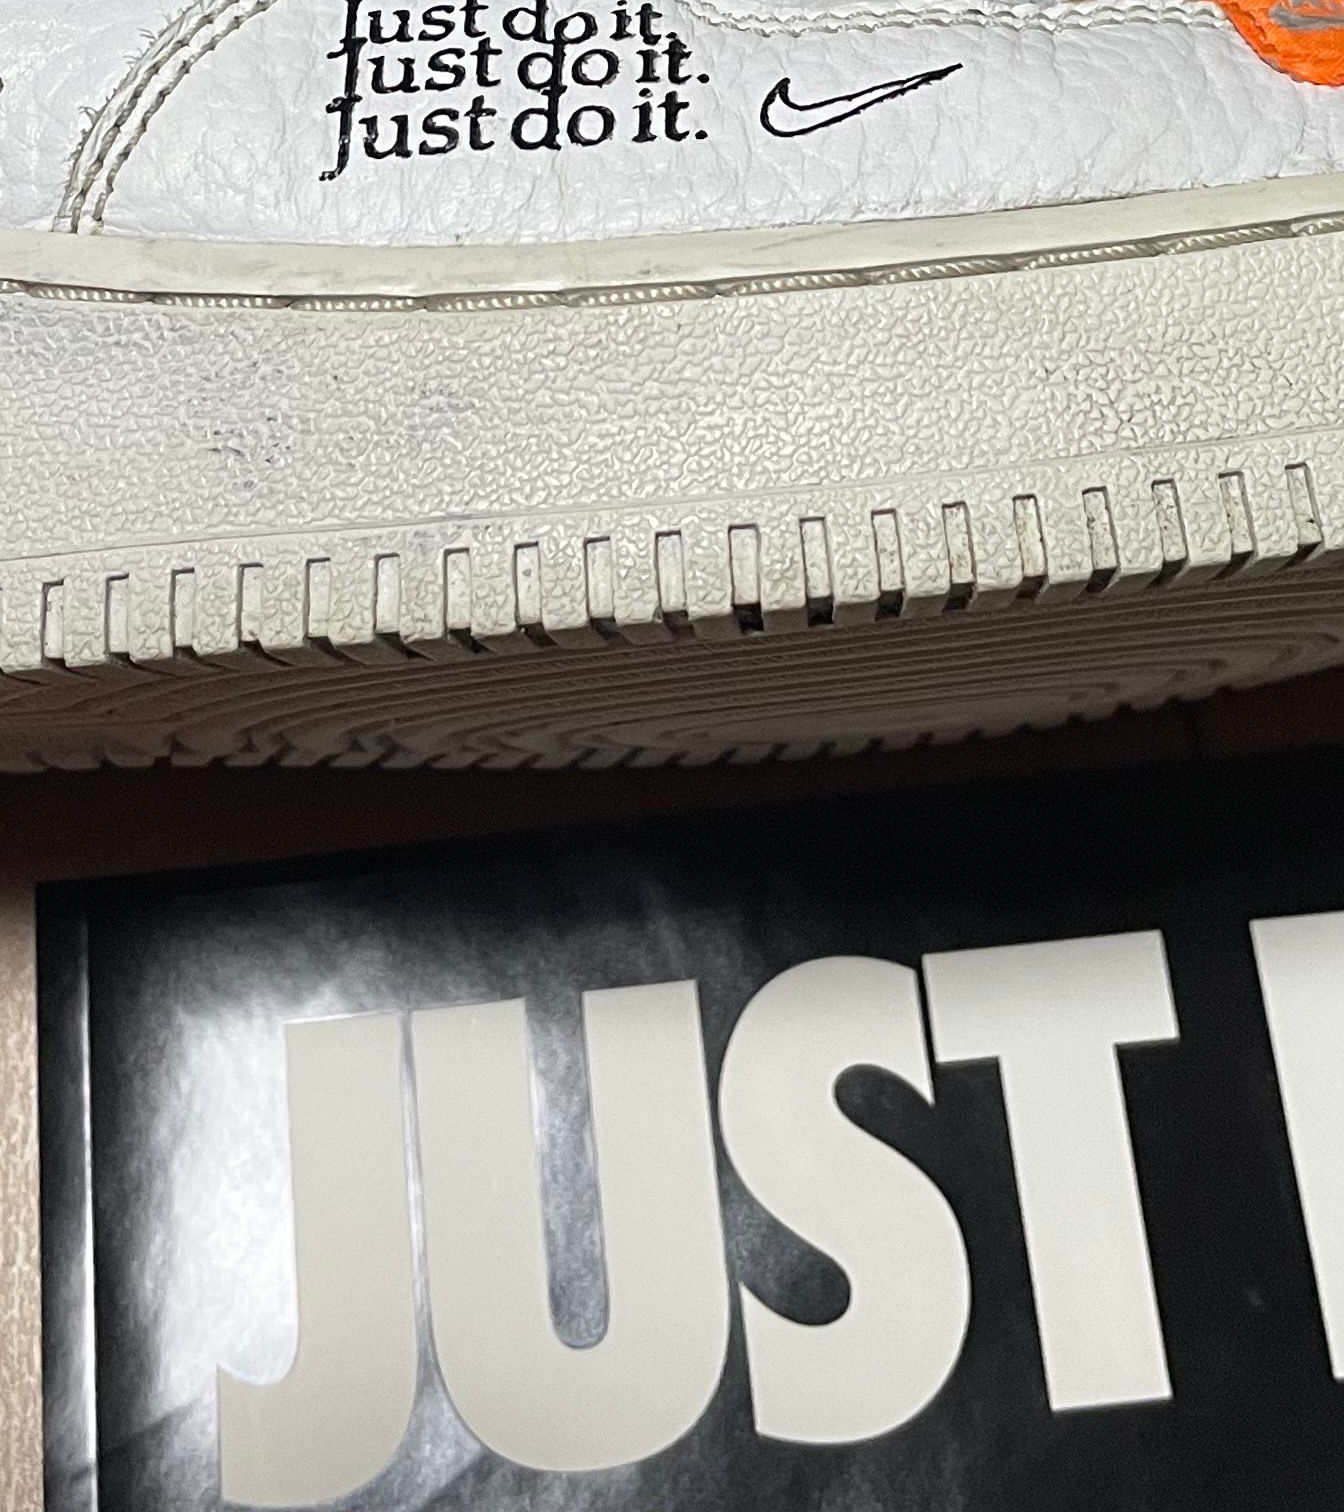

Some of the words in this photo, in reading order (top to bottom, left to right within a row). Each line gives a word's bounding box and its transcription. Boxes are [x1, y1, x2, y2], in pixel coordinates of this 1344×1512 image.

[517, 22, 622, 92] do
[636, 33, 710, 85] it.
[319, 94, 501, 181] Just
[510, 86, 616, 151] do
[630, 86, 710, 144] it.
[218, 929, 1180, 1506] JUST
